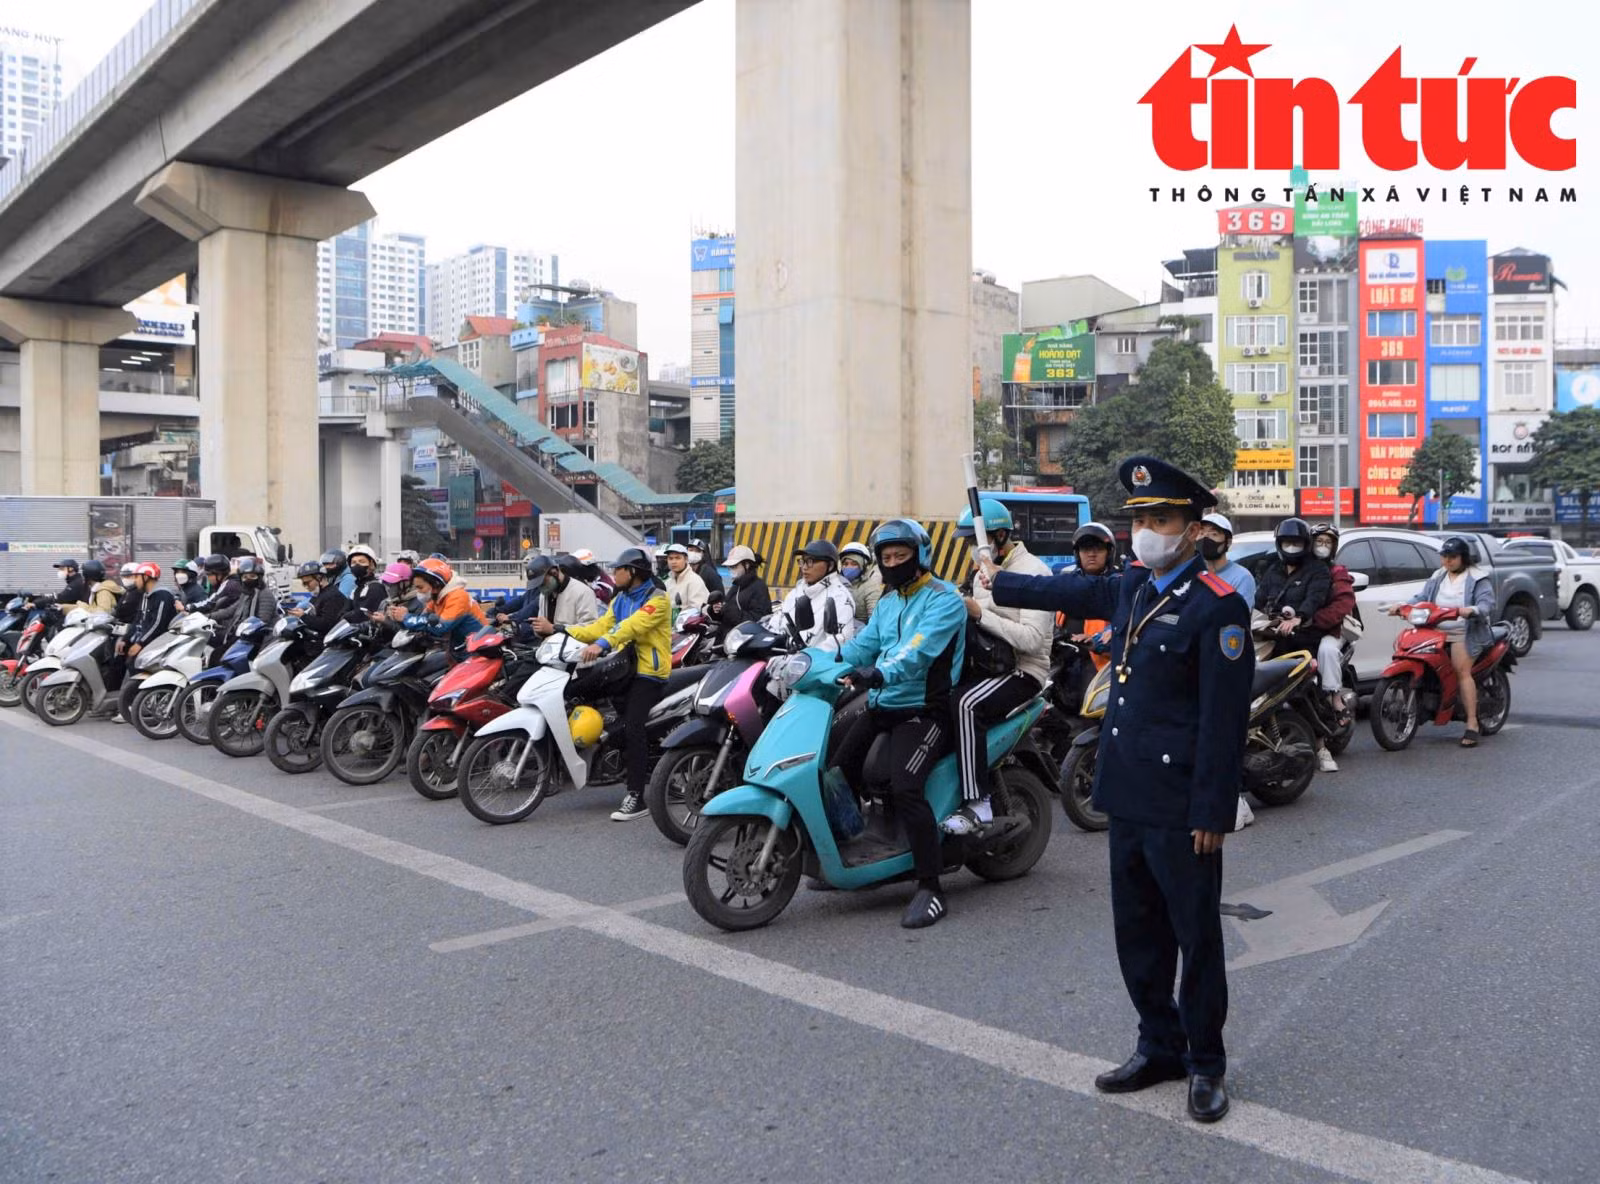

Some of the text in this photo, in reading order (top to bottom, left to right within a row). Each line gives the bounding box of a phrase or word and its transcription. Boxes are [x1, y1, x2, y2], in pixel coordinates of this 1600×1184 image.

[0, 25, 30, 39] ANG
[1227, 211, 1286, 231] 369
[1370, 285, 1395, 307] LUẬT
[1380, 341, 1404, 357] 369
